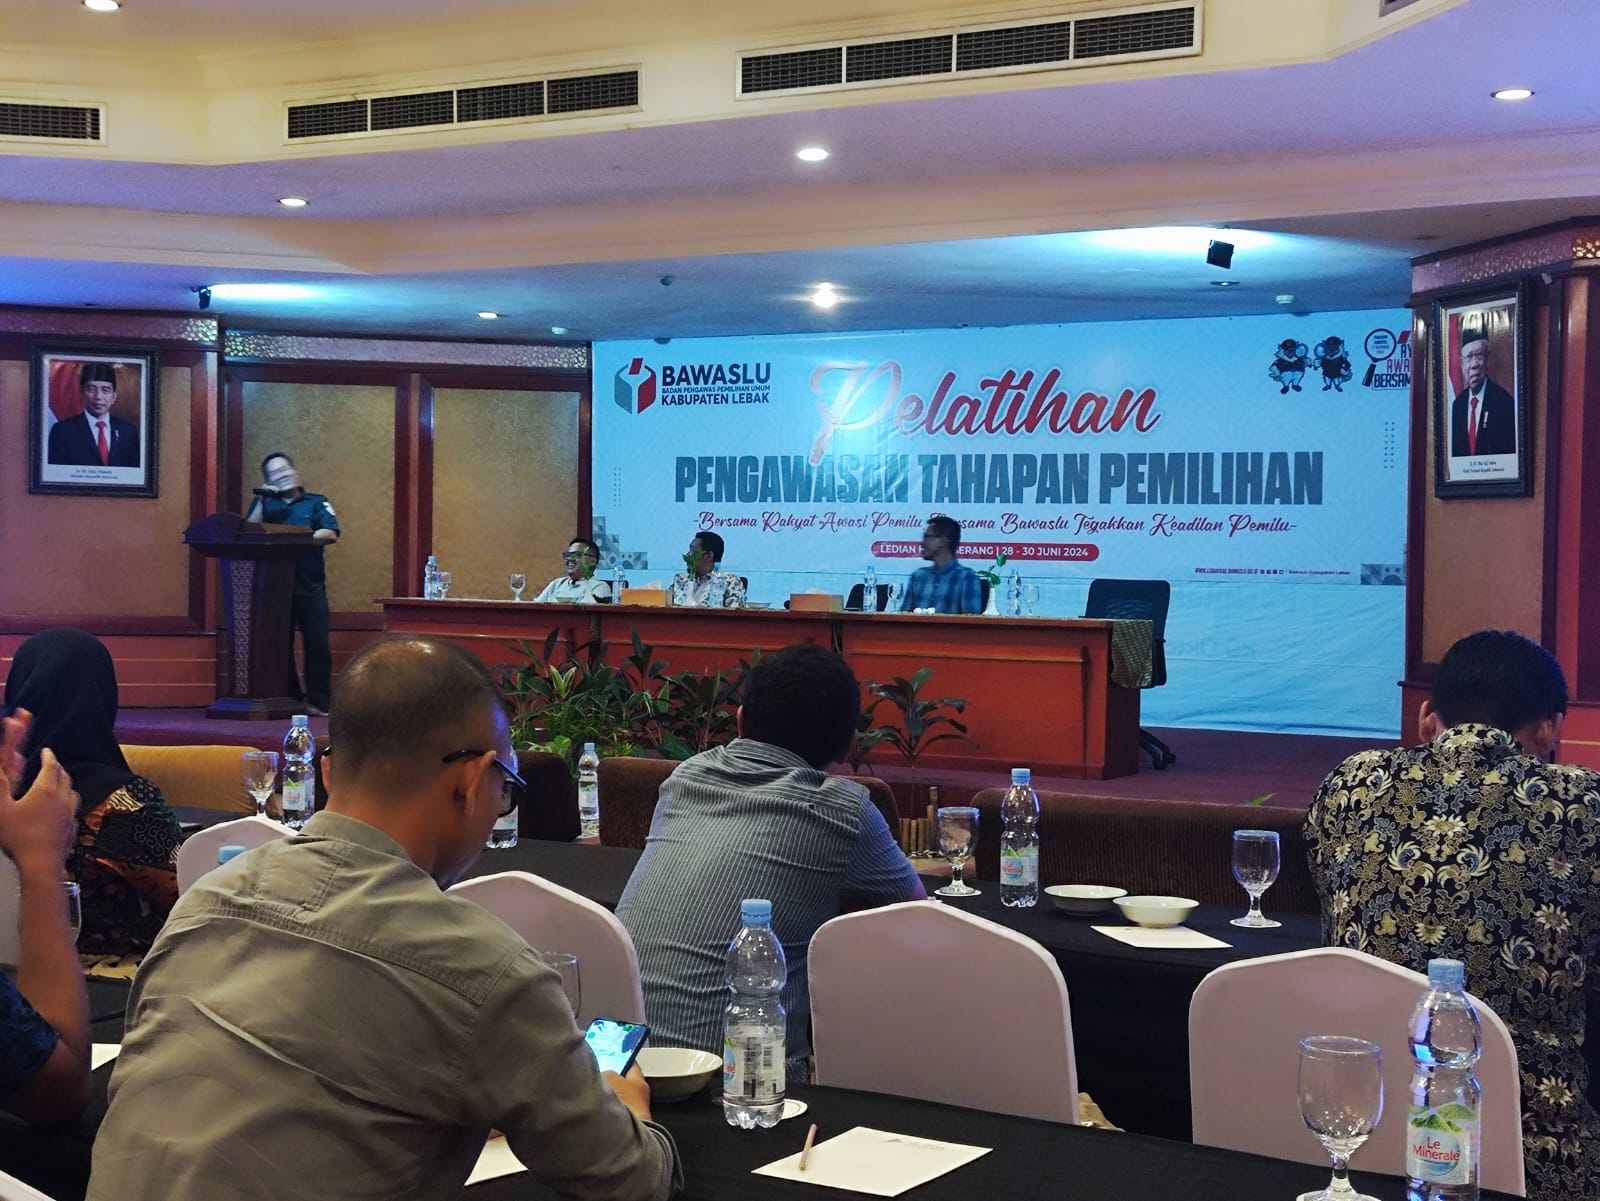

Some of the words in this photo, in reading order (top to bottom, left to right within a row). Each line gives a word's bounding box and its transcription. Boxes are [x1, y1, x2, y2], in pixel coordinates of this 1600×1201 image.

[1400, 344, 1412, 358] AY
[1386, 359, 1410, 373] AWA
[662, 362, 771, 386] BAWASLU
[1374, 373, 1411, 388] BERSAM
[661, 393, 729, 406] KABUPATEN
[731, 392, 770, 404] LEBAK
[810, 361, 1161, 464] Pelatihan
[675, 453, 910, 504] PENGAWASAN
[917, 452, 1090, 504] TAHAPAN
[1100, 451, 1323, 505] PEMILIHAN
[761, 511, 816, 533] Rakyat
[819, 511, 868, 533] Awasi
[871, 511, 922, 533] Pemilu
[1000, 512, 1069, 535] Bawaslu
[1073, 513, 1145, 536] Tegakkan
[1149, 513, 1224, 537] Keadilan
[880, 544, 916, 554] LEDIAN
[1002, 546, 1014, 556] 28
[1022, 547, 1035, 557] 30
[1037, 547, 1061, 557] JUNI
[1063, 547, 1089, 557] 2024
[1426, 1136, 1441, 1149] Le
[1412, 1144, 1460, 1161] Minerale
